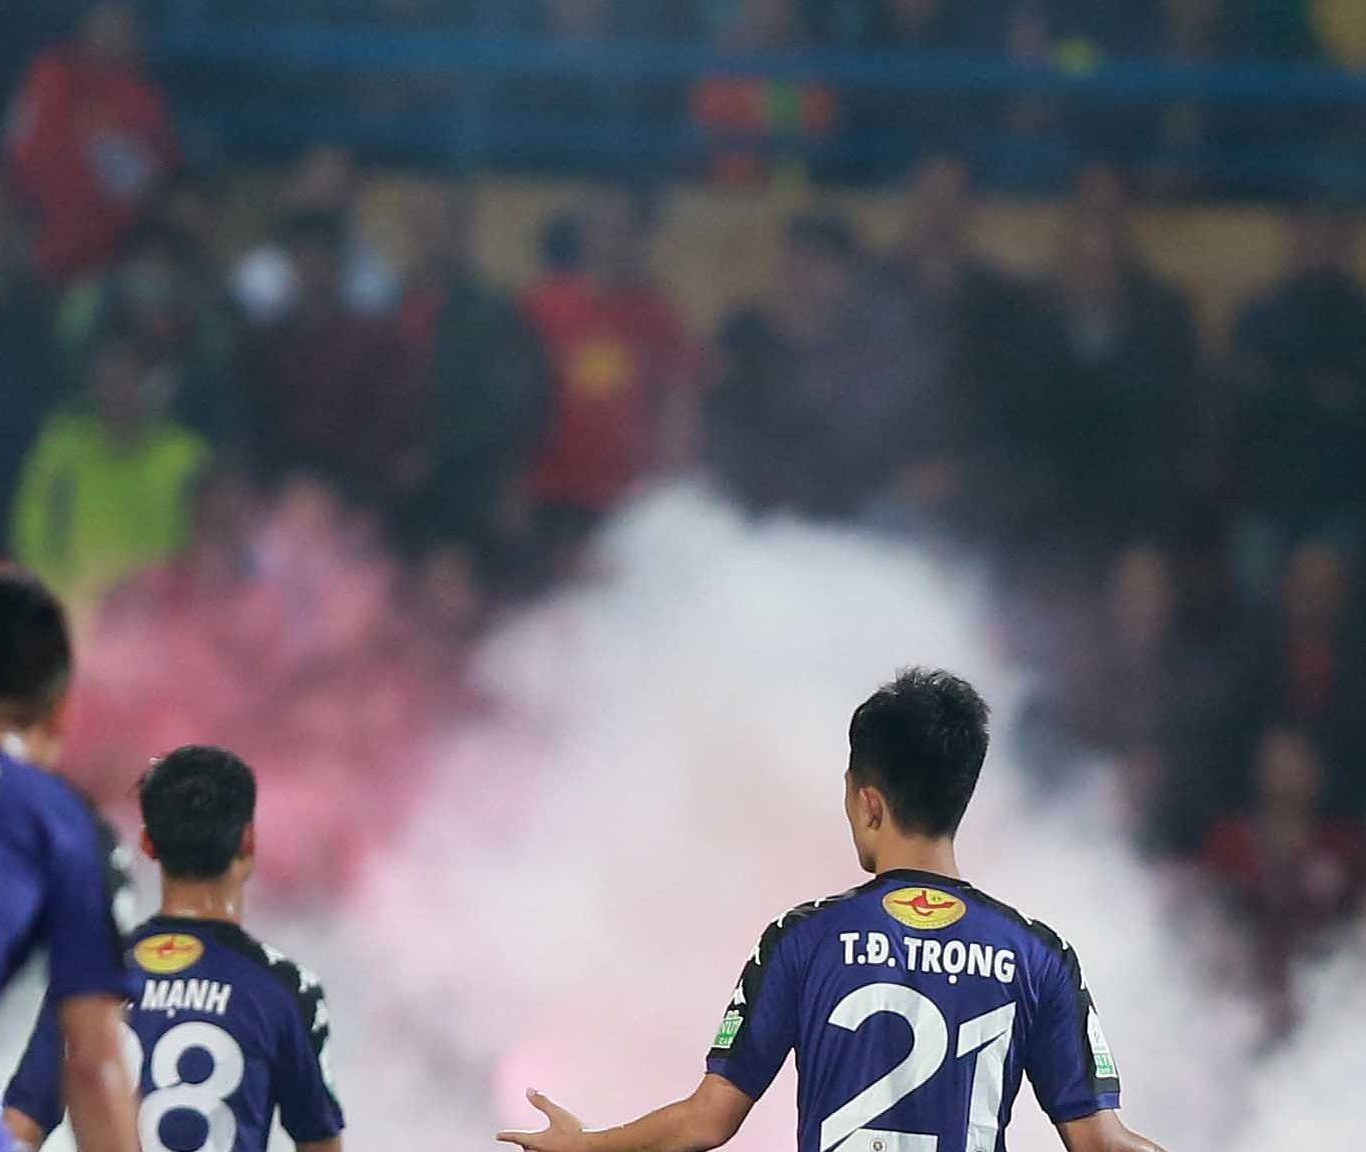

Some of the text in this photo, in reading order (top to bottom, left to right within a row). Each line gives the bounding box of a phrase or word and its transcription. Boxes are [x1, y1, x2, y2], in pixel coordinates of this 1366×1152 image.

[840, 932, 1016, 984] T.Đ. TRỌNG
[140, 979, 232, 1018] MẠNH
